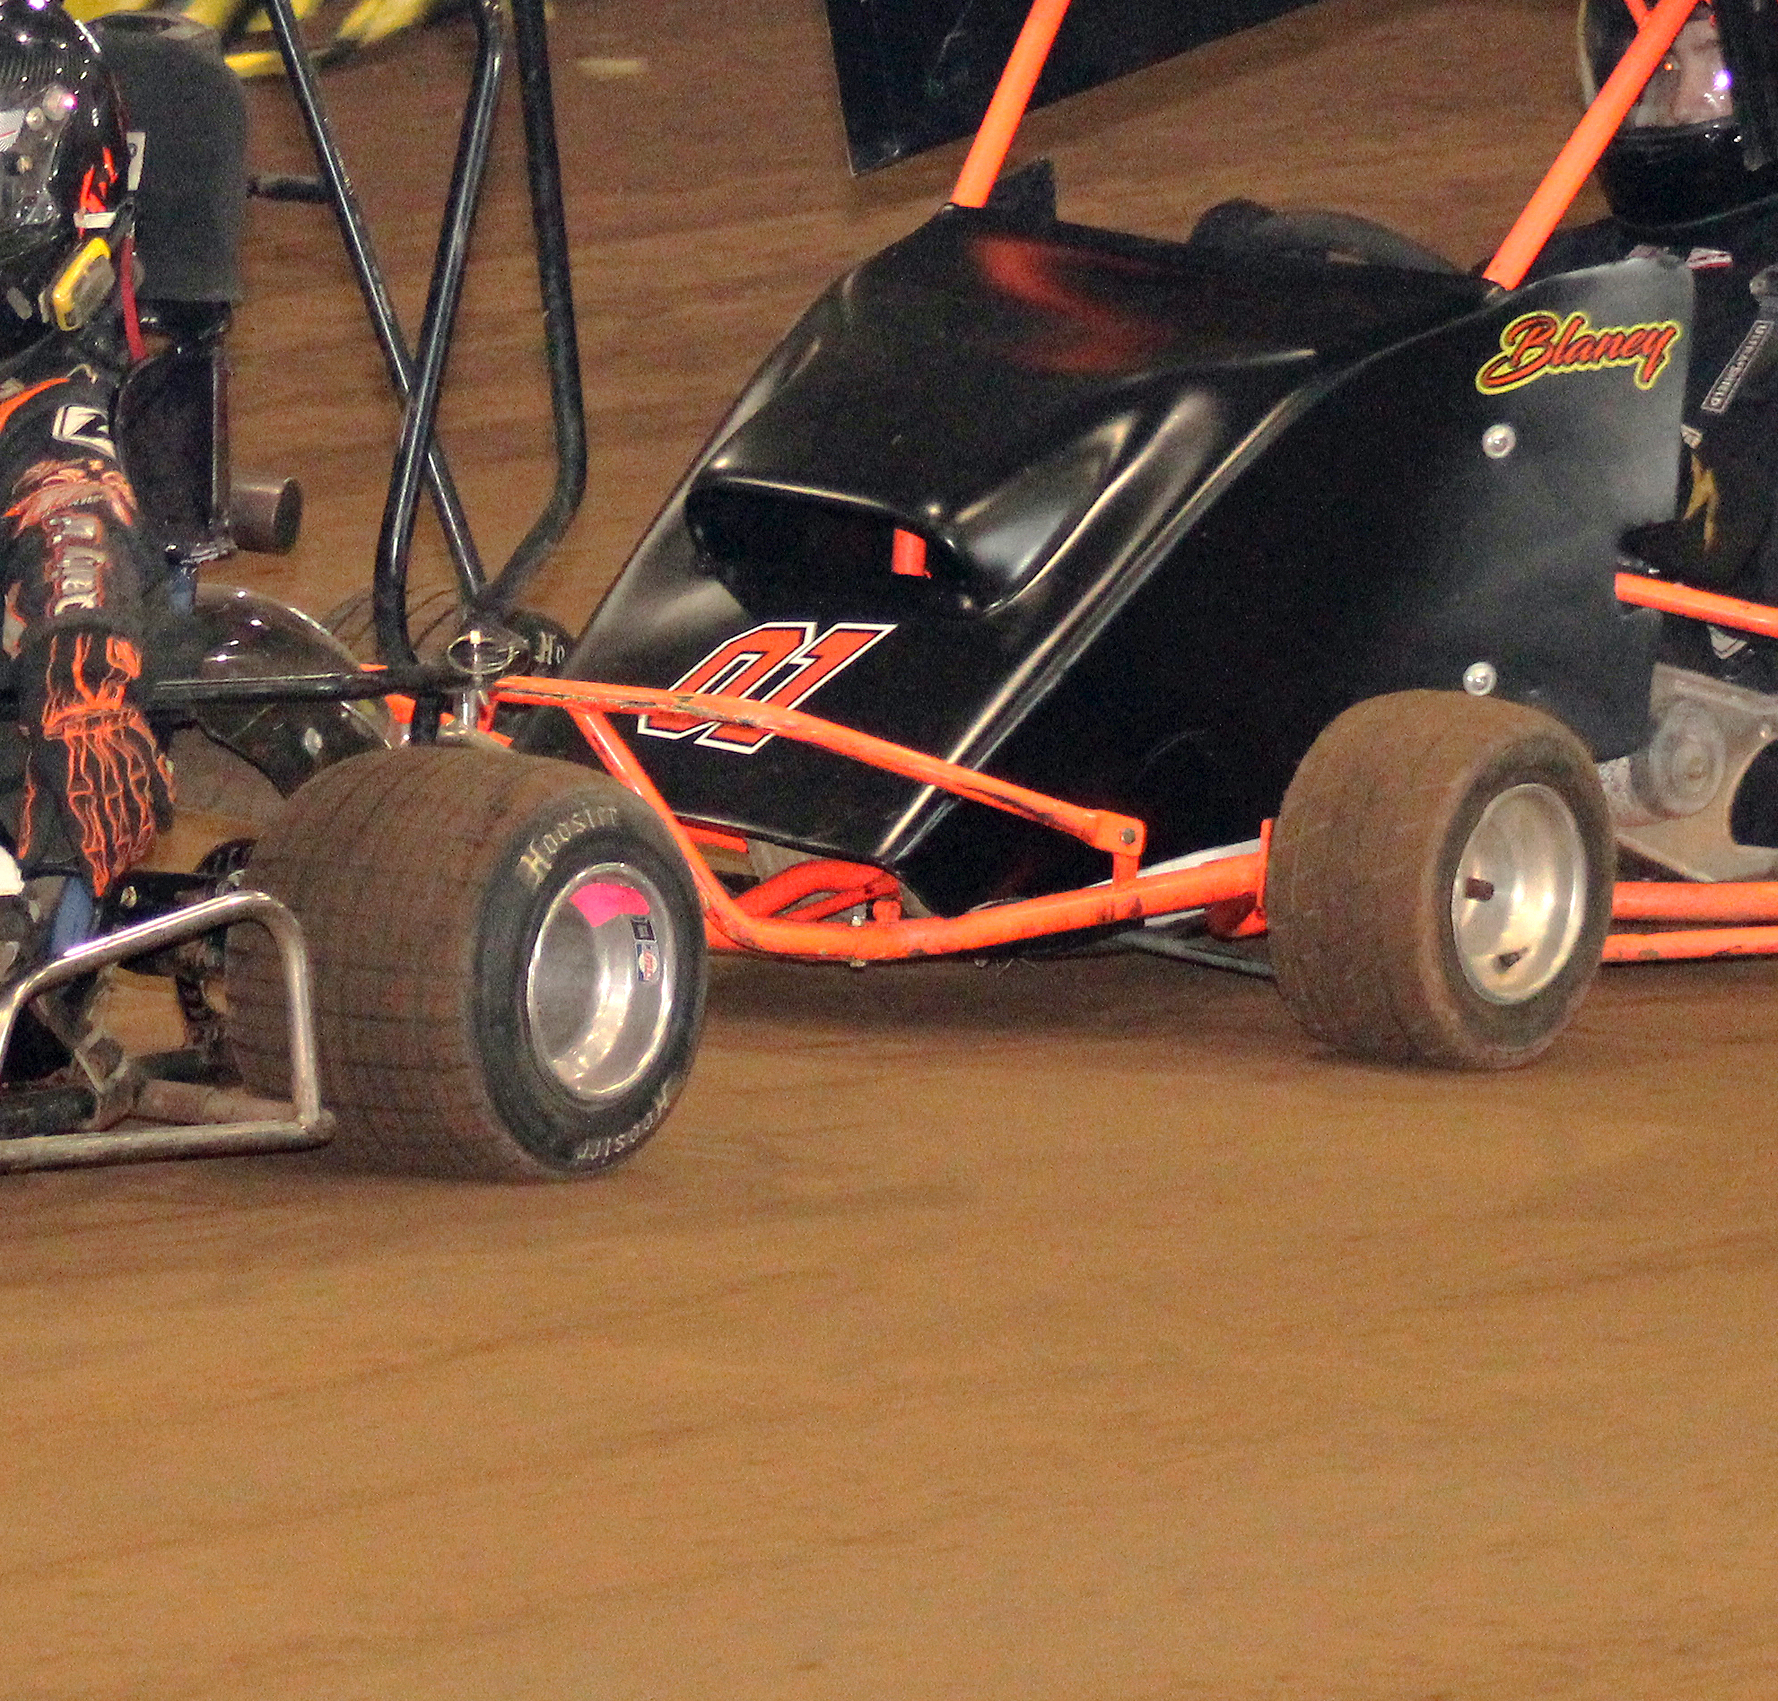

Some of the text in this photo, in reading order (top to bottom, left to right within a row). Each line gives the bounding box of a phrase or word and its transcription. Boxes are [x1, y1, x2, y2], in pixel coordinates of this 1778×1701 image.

[1475, 310, 1681, 395] Blaney
[637, 621, 898, 755] 01
[522, 803, 620, 883] Hoosier
